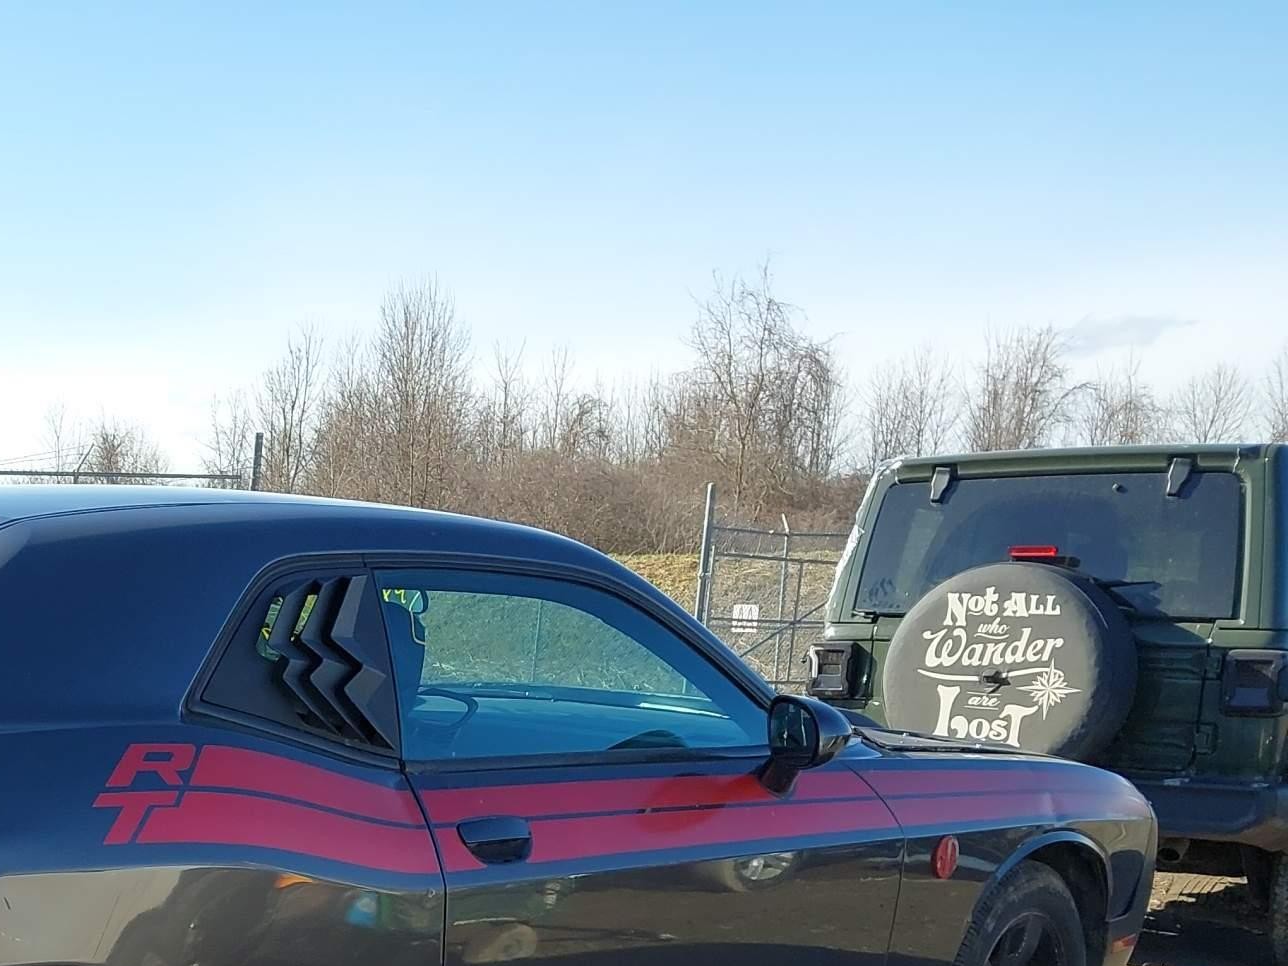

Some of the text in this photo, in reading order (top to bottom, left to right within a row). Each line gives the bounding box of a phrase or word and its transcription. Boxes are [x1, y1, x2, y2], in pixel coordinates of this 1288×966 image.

[943, 586, 999, 626] Not
[978, 617, 1009, 635] who
[922, 628, 1064, 667] Wander
[968, 694, 1000, 707] are
[106, 743, 196, 787] R
